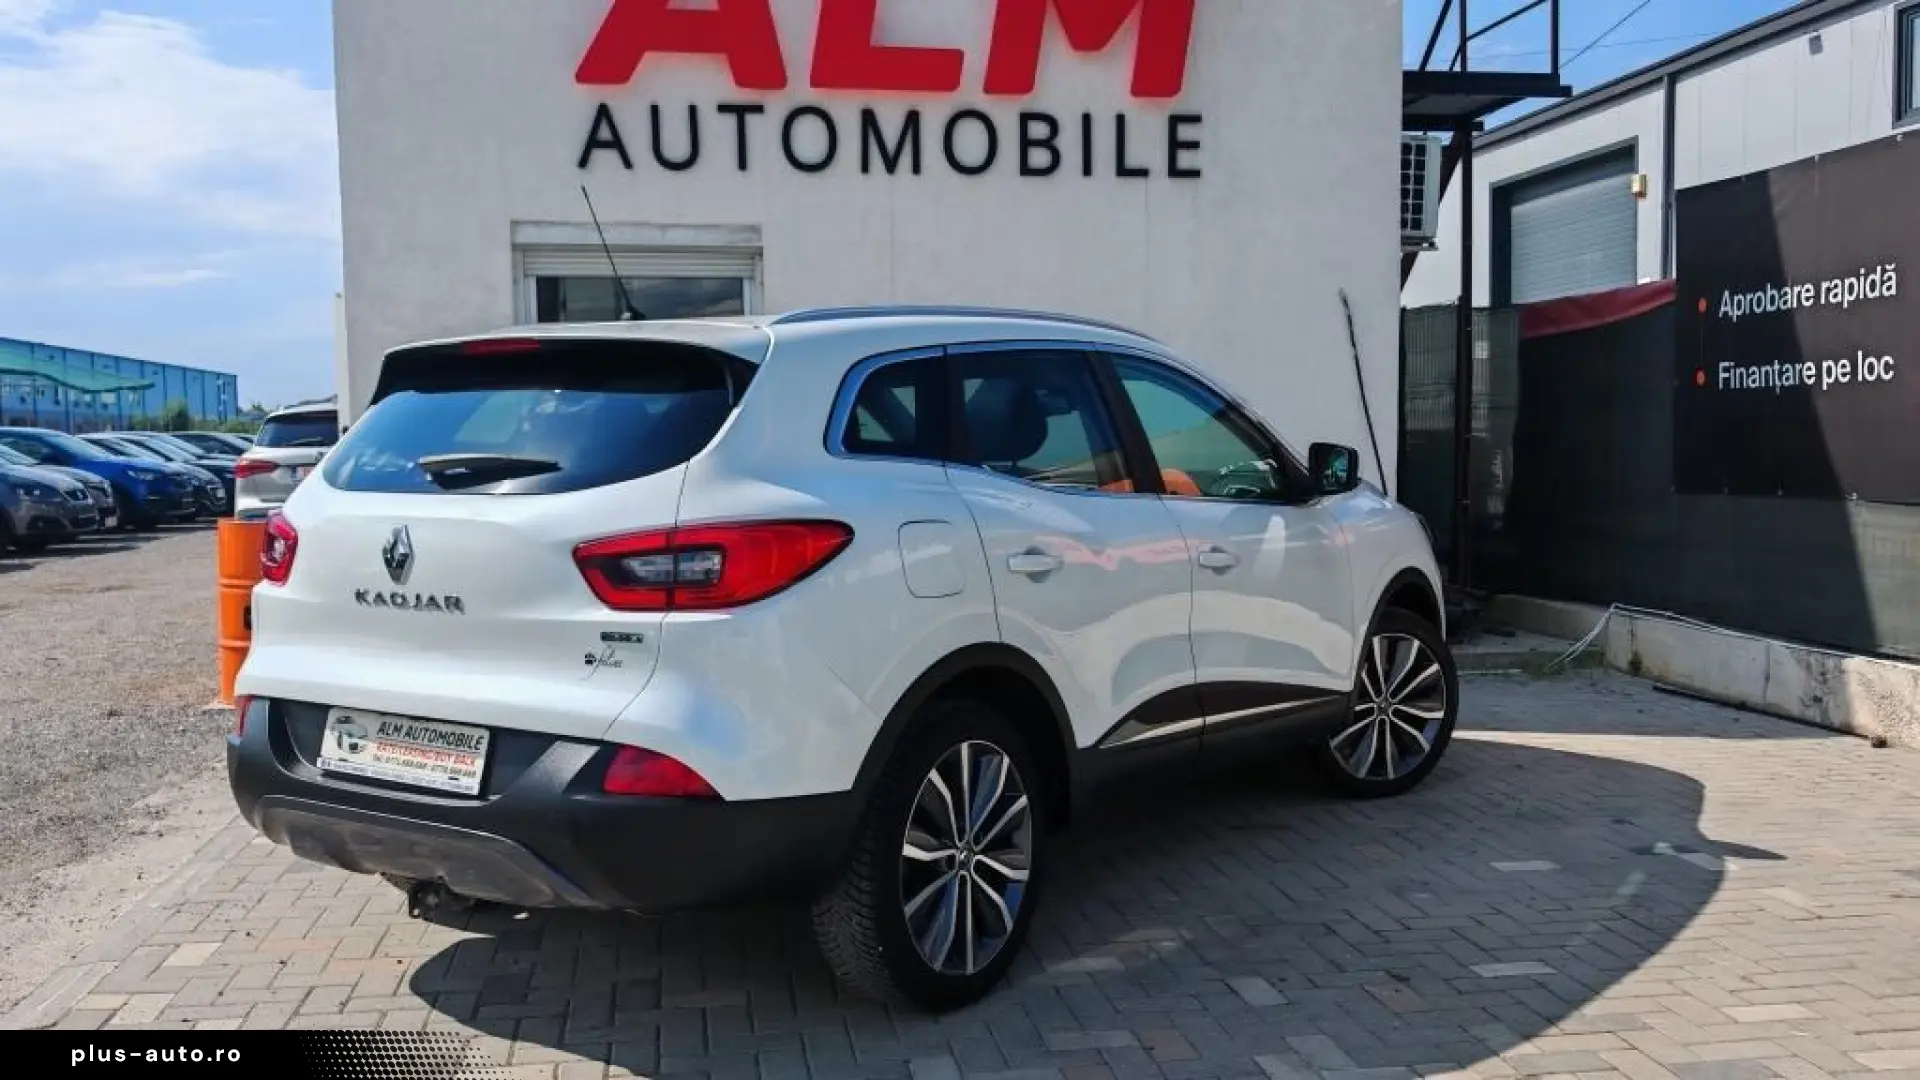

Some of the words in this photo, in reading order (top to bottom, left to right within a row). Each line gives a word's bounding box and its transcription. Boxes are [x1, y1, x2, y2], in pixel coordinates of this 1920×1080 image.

[577, 102, 1203, 179] AUTOMOBILE
[1718, 282, 1815, 323] Aprobare
[1820, 262, 1898, 309] rapidă
[1822, 359, 1852, 391] pe
[1857, 350, 1895, 382] loc
[354, 588, 466, 615] KADJAR
[376, 721, 404, 737] ALM
[404, 725, 485, 750] AUTOMOBILE
